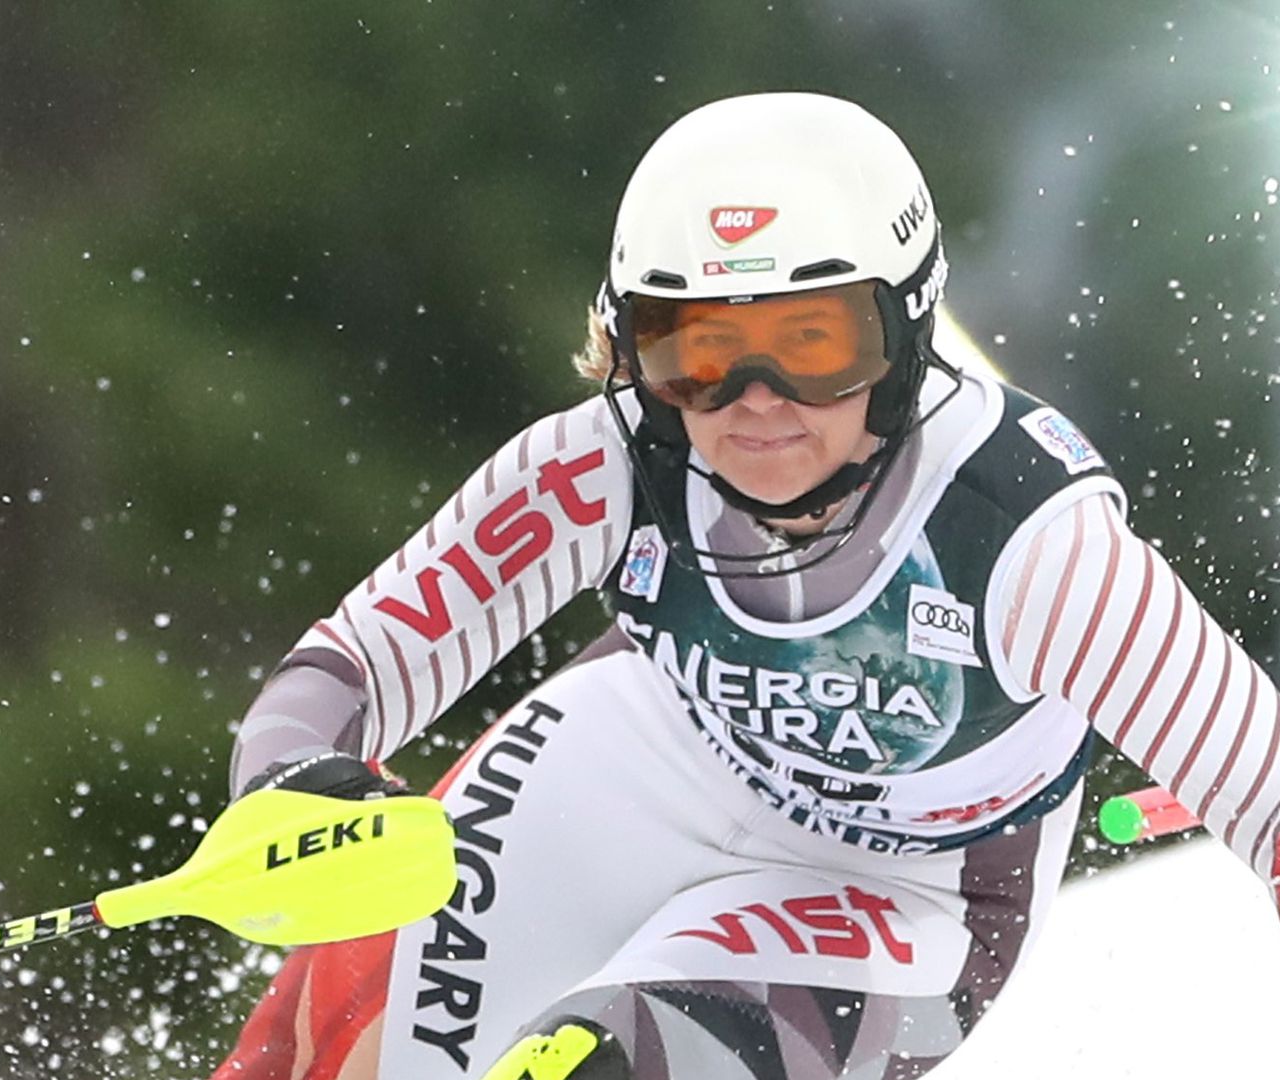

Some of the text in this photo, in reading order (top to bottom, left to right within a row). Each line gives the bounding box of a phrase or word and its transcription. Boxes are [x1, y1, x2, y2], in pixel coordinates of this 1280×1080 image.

[715, 210, 755, 228] MOL
[720, 708, 885, 762] URA
[266, 813, 385, 871] LEKI
[412, 699, 565, 1073] HUNGARY
